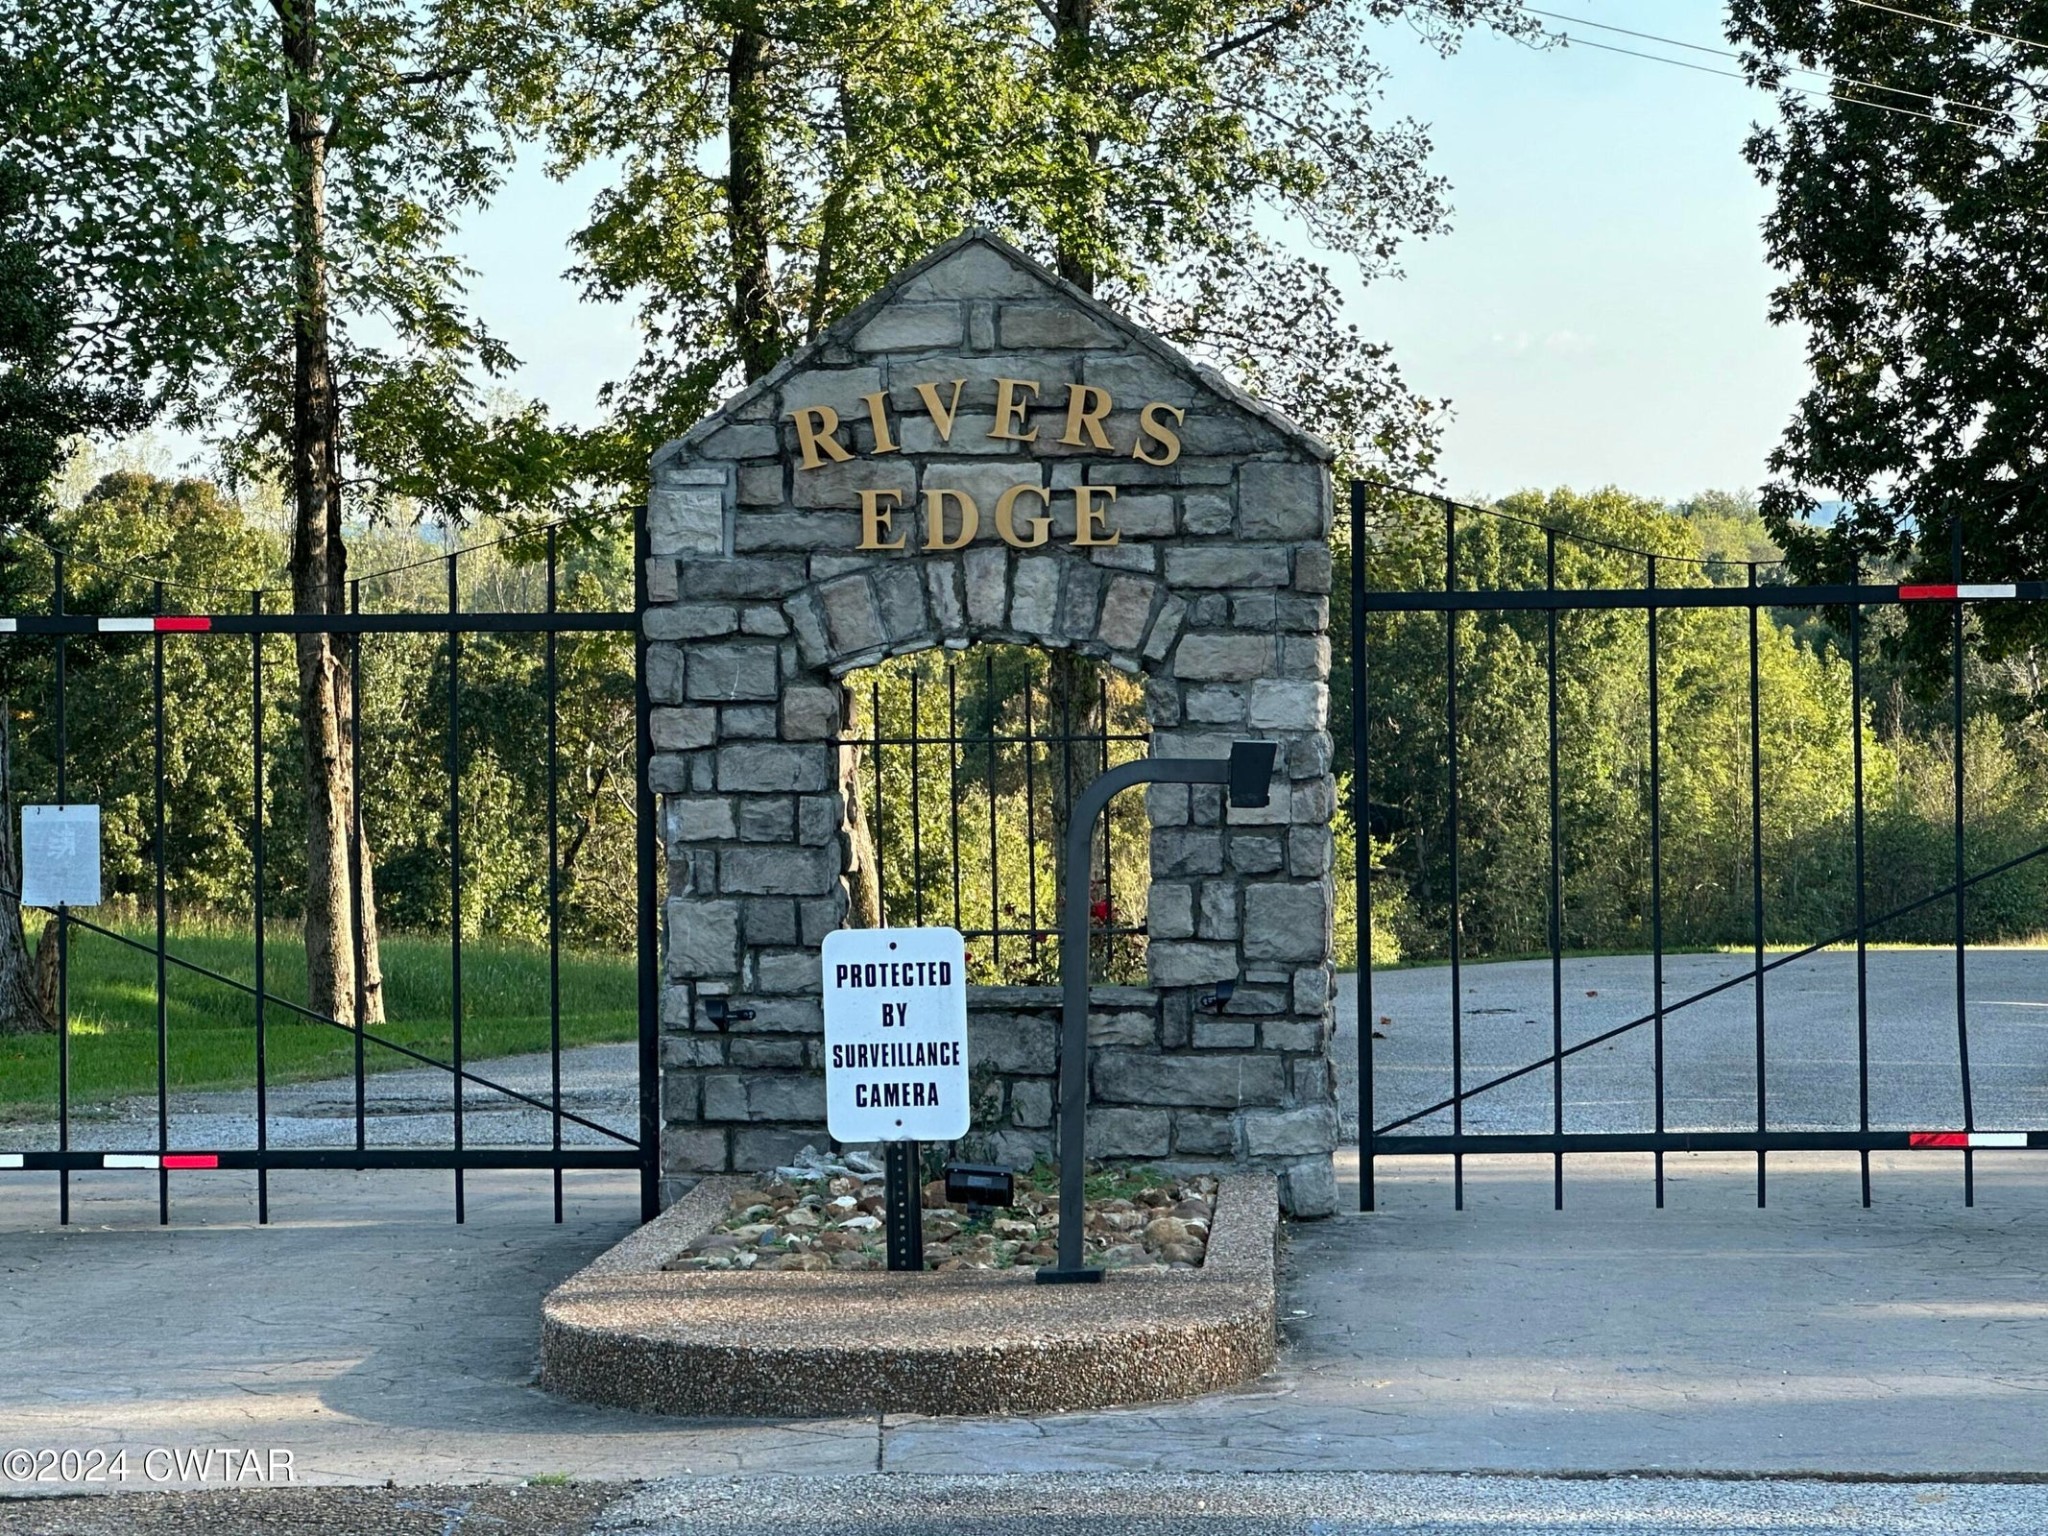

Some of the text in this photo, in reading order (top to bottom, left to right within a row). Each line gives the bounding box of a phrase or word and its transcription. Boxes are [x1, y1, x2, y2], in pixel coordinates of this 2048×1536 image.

[787, 378, 1185, 470] RIVERS
[856, 484, 1121, 550] EDGE
[836, 961, 952, 988] PROTECTED
[882, 1002, 907, 1027] BY
[833, 1041, 960, 1069] SURVEILLANCE
[855, 1082, 939, 1108] CAMERA
